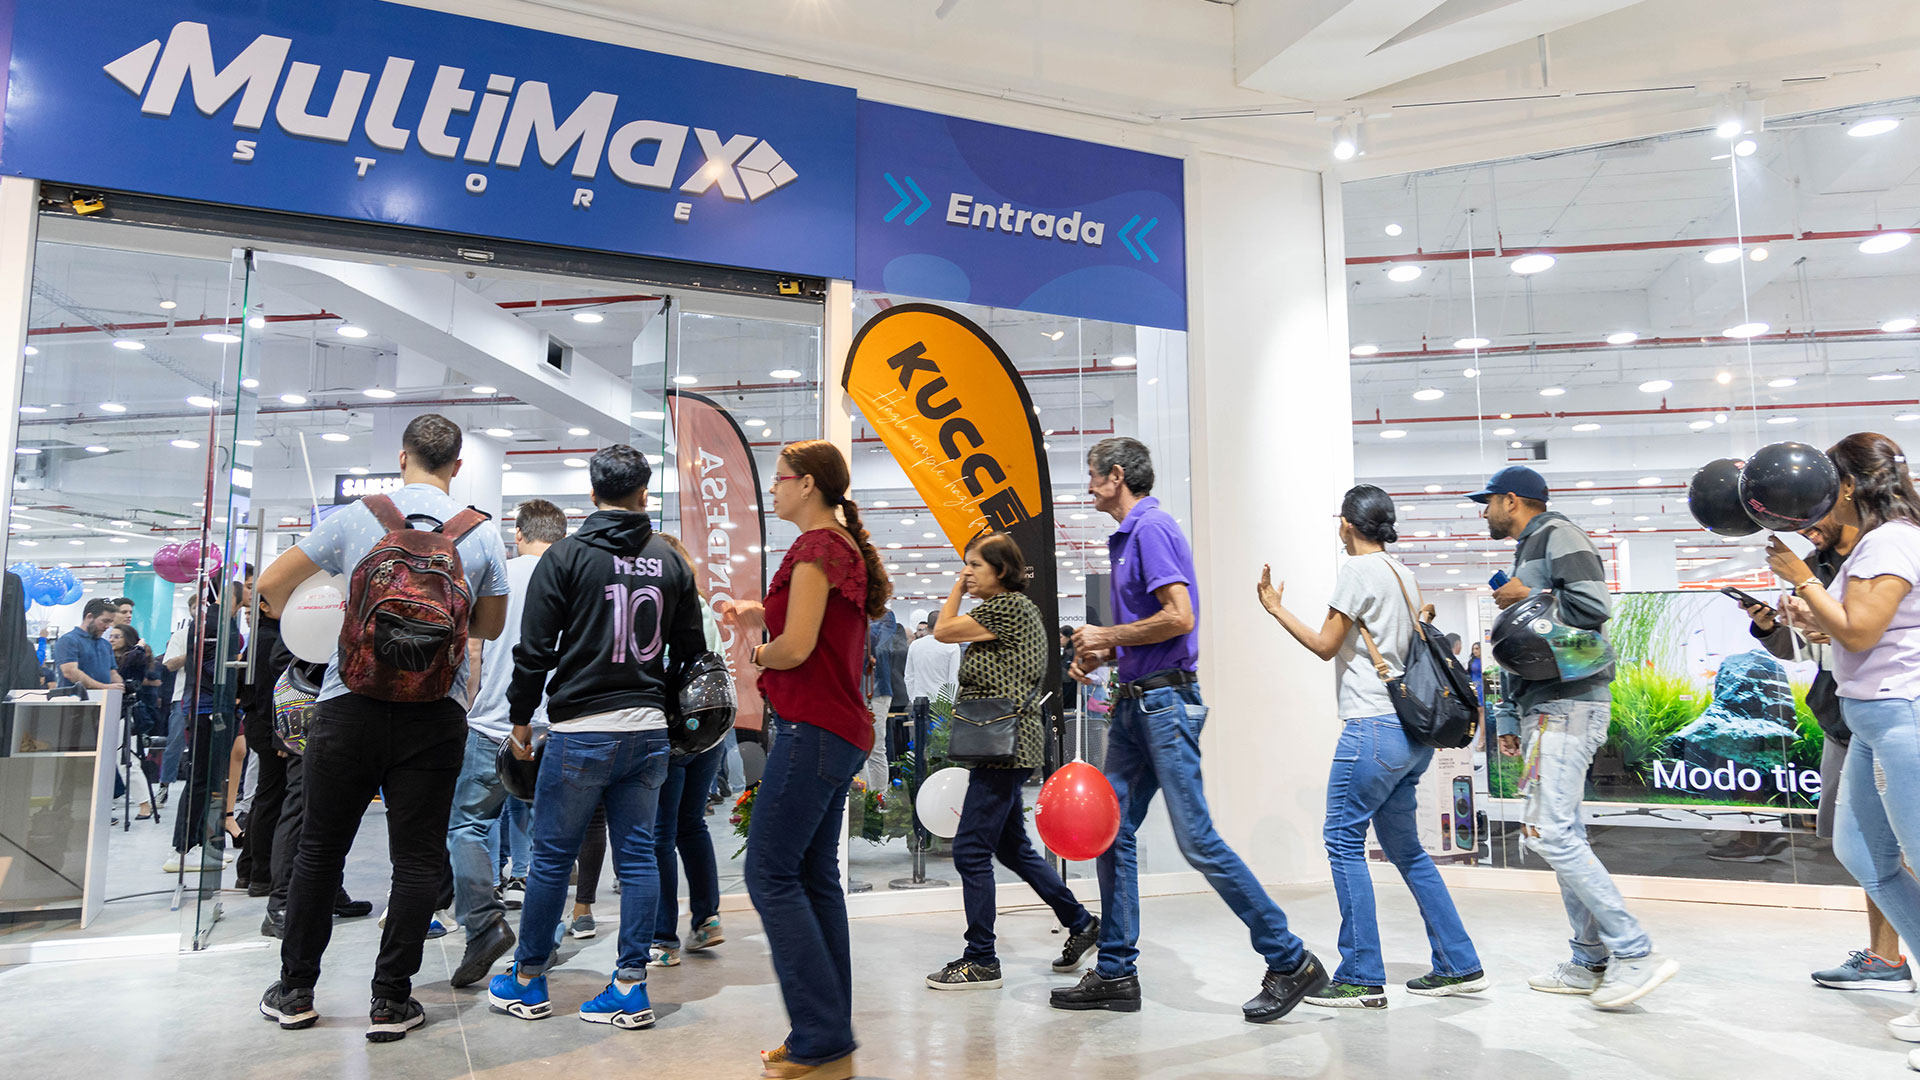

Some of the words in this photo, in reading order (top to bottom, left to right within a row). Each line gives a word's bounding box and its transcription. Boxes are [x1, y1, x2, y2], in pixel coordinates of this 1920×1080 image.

[141, 20, 757, 200] MultiMax
[232, 139, 693, 222] STORE
[945, 192, 1105, 245] Entrada
[886, 341, 1028, 534] KUCCE
[613, 555, 662, 577] MESSI
[604, 583, 664, 665] 10
[1652, 759, 1762, 792] Modo
